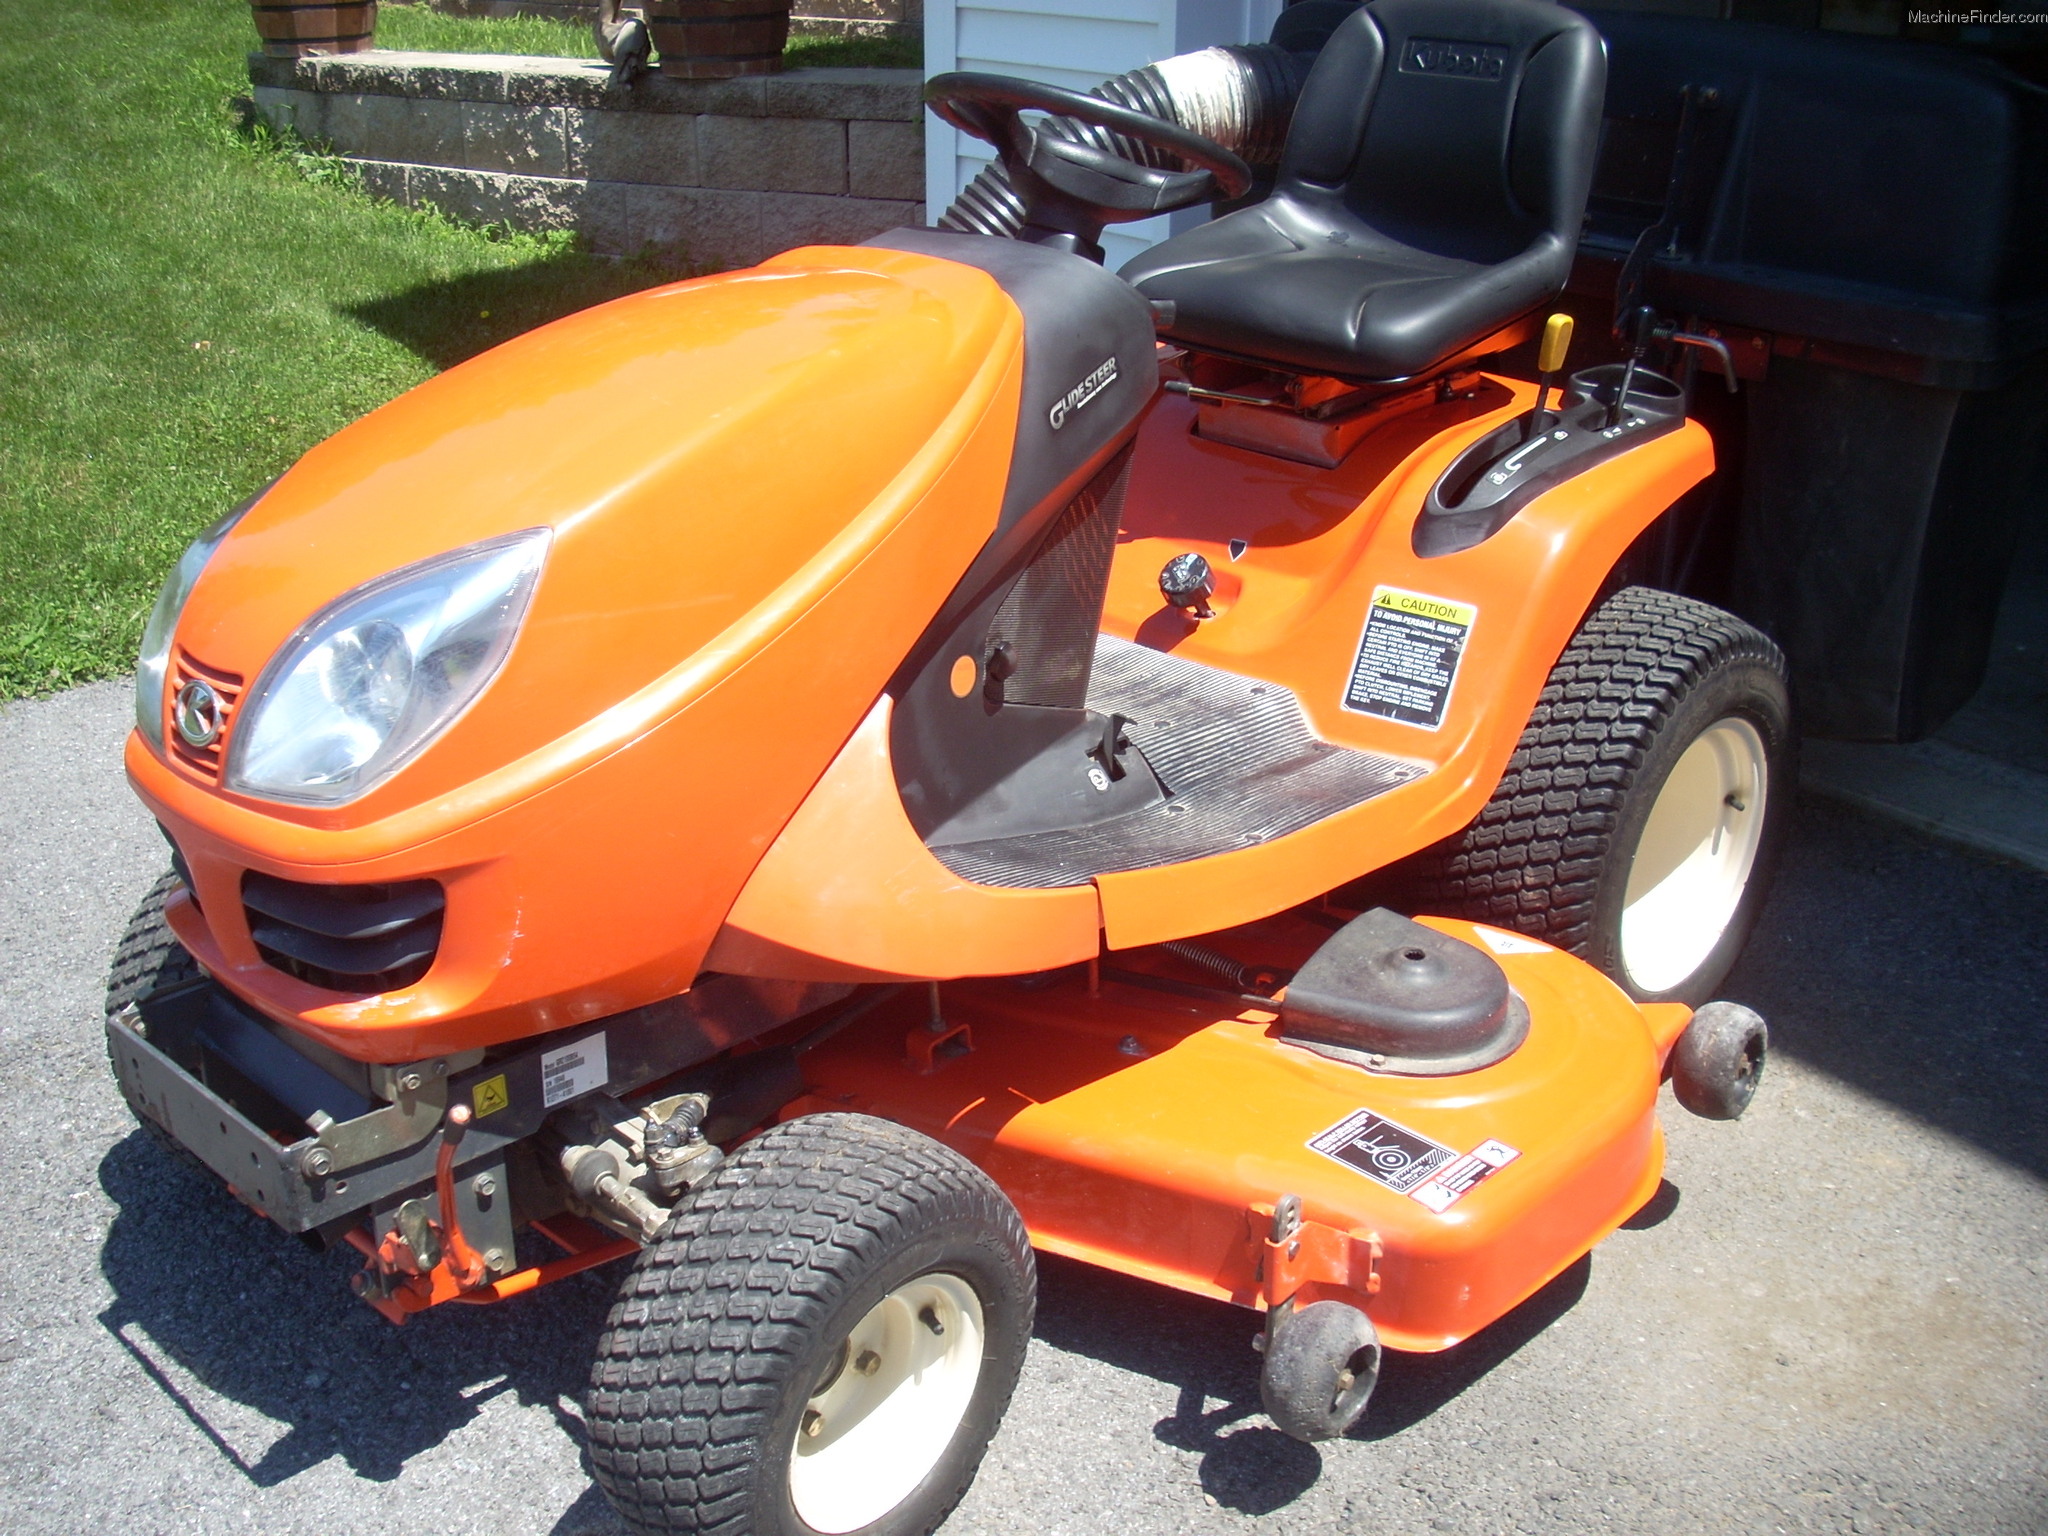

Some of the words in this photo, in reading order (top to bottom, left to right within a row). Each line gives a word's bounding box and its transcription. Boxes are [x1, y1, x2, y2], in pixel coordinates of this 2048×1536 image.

[1401, 598, 1457, 618] CAUTION
[1373, 610, 1383, 618] TO
[1382, 612, 1403, 623] AVOID
[1403, 617, 1437, 630] PERSONAL
[1437, 624, 1462, 635] INJURY
